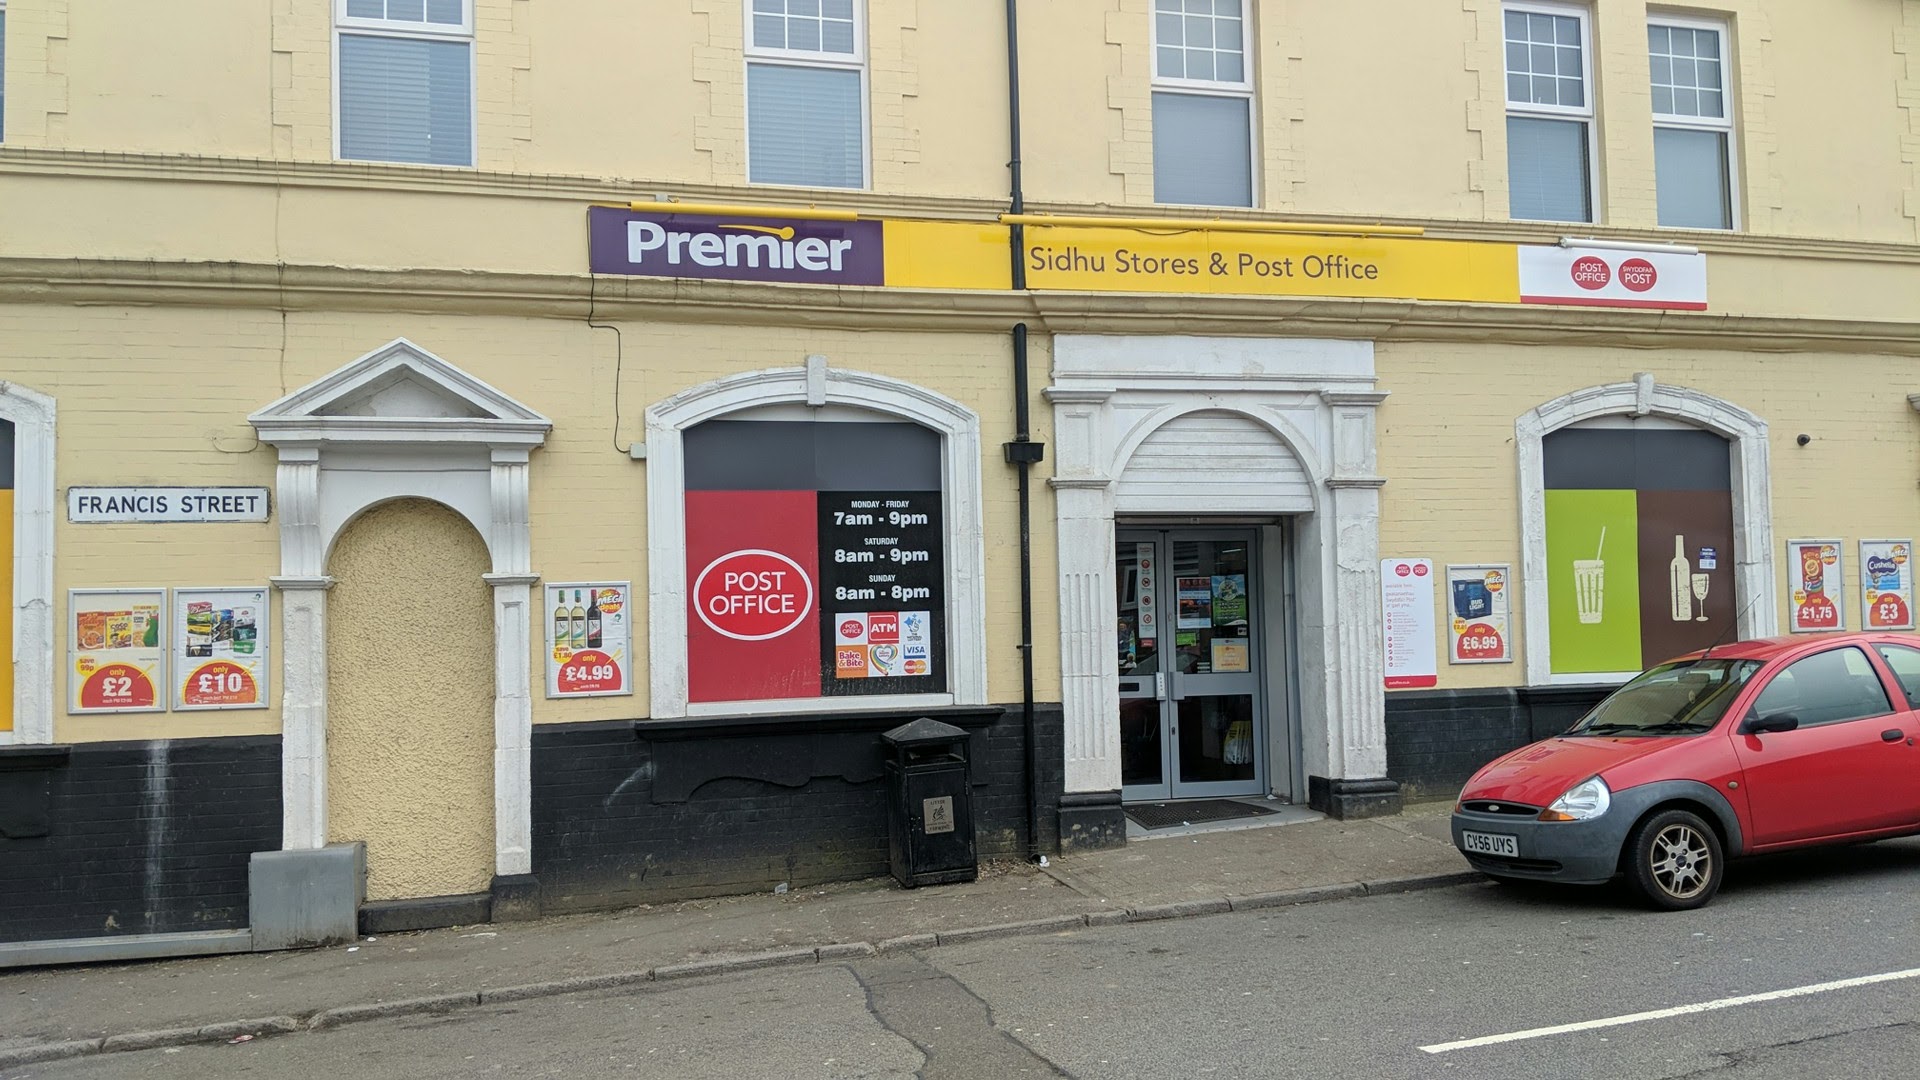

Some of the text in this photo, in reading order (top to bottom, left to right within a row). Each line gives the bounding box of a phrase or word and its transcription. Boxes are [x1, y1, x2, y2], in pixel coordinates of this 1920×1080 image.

[627, 220, 852, 272] Premier
[1030, 246, 1378, 280] Sidhu Stores & Post Office
[1580, 263, 1602, 272] POST
[1575, 272, 1606, 282] OFFICE
[1624, 273, 1652, 284] POST
[78, 495, 259, 513] FRANCIS STREET
[886, 500, 909, 508] FRIDAY
[834, 511, 873, 525] 7am
[889, 511, 928, 528] 9pm
[834, 549, 874, 562] 8am
[890, 548, 929, 565] 9pm
[725, 571, 786, 592] POST
[835, 586, 875, 600] 8am
[891, 585, 930, 602] 8pm
[709, 594, 795, 615] OFFICE
[1802, 606, 1832, 619] £1.75
[1880, 603, 1898, 620] £3
[871, 623, 897, 632] ATM
[1463, 636, 1498, 650] £6.99
[839, 652, 860, 660] Bake
[109, 668, 126, 676] only
[213, 666, 229, 674] only
[566, 664, 613, 681] £4.99
[102, 676, 132, 697] £2
[199, 672, 242, 693] £10
[1492, 837, 1514, 854] UYS
